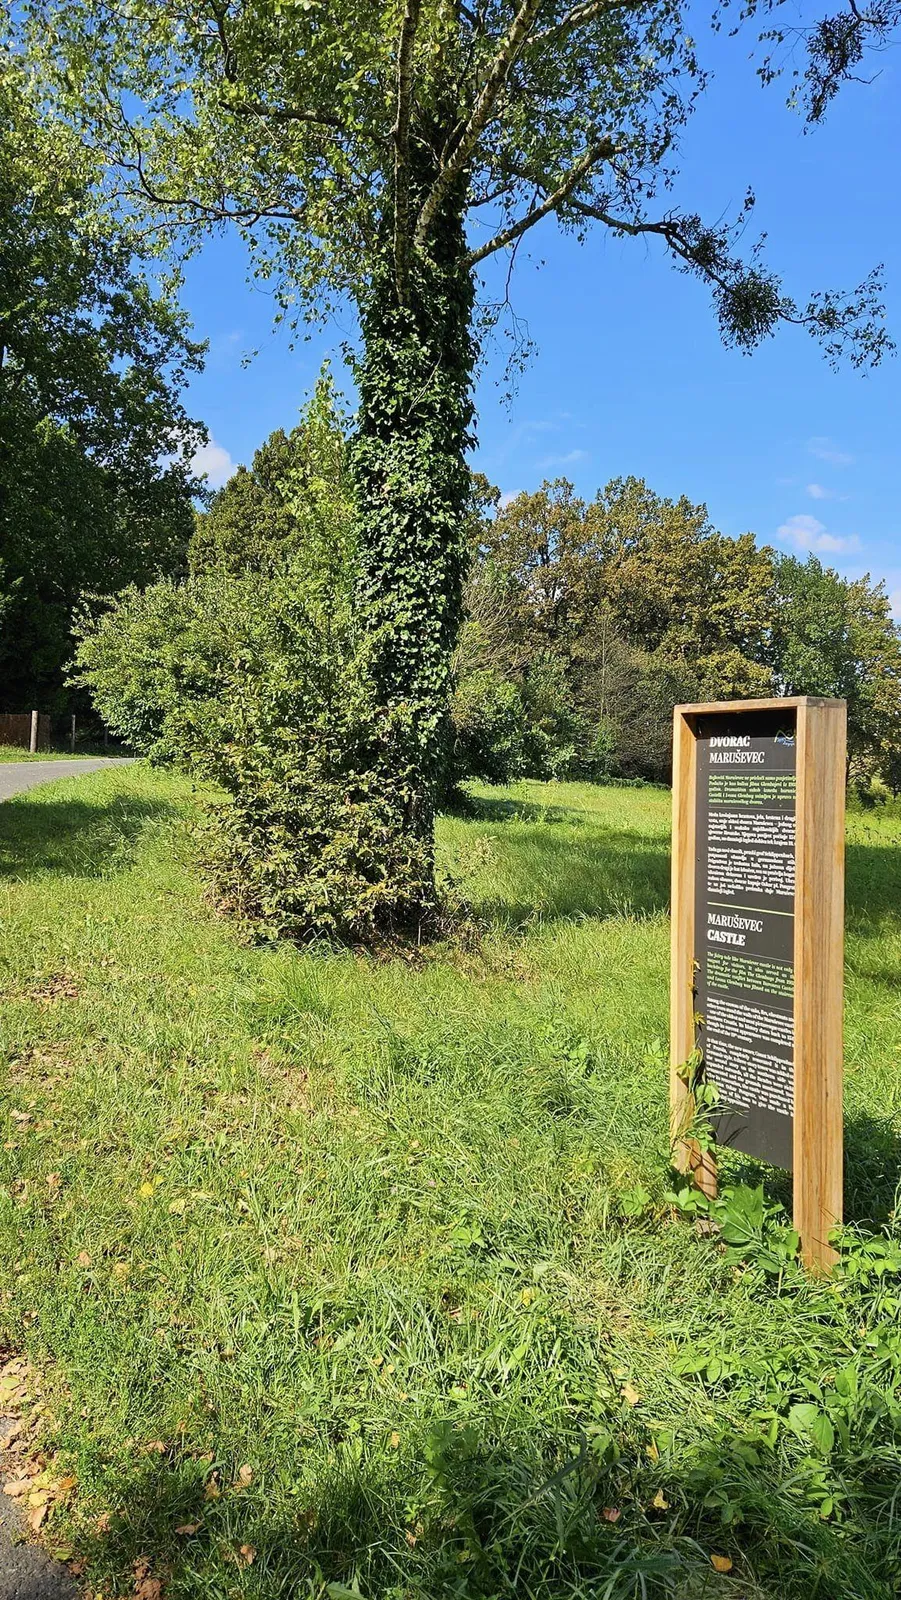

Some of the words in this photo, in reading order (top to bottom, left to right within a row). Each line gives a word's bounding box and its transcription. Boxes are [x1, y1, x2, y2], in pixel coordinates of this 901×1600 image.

[710, 736, 750, 747] DVORAC
[710, 749, 765, 764] MARUŠEVEC
[707, 913, 763, 932] MARUŠEVEC
[707, 930, 746, 946] CASTLE
